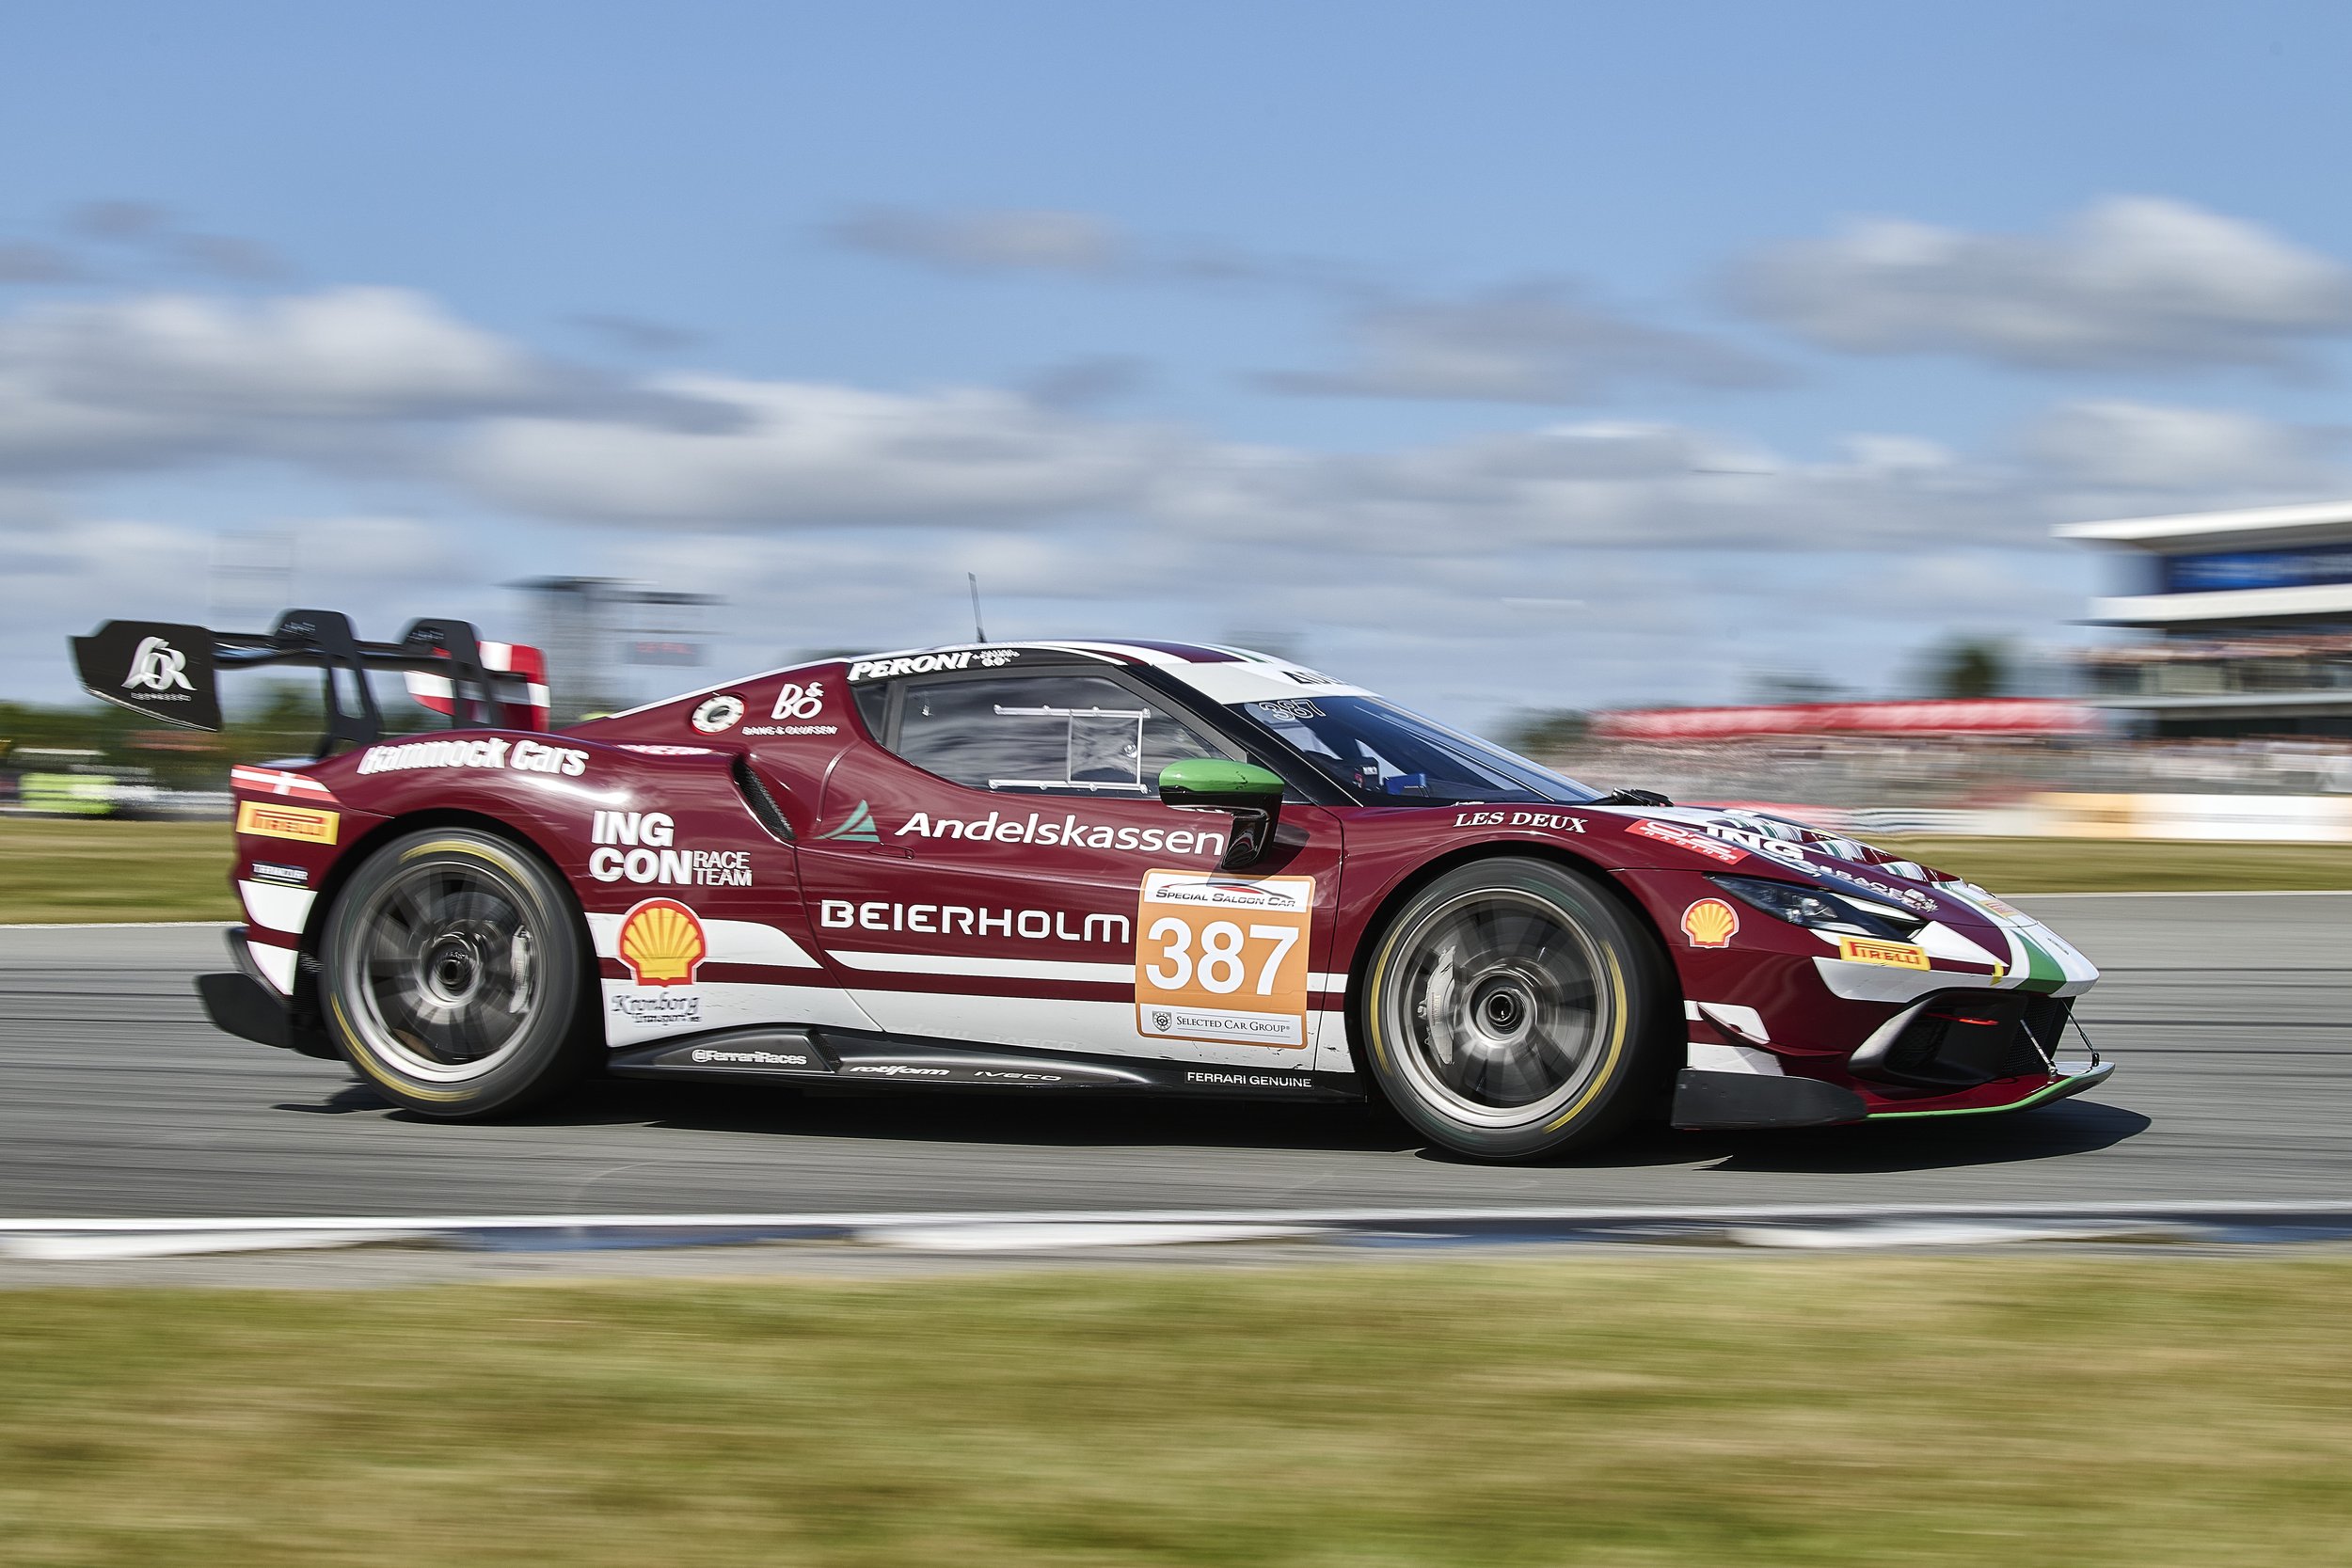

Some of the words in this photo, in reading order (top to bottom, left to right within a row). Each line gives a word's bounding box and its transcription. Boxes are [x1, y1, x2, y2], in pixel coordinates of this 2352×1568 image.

[847, 653, 973, 681] PERONI
[1259, 699, 1327, 721] 387
[741, 726, 776, 736] BANG
[775, 726, 786, 736] &
[785, 725, 838, 736] OLUFSEN
[509, 739, 590, 777] Cars
[591, 810, 675, 847] ING
[894, 811, 1224, 857] Andelskassen
[1453, 812, 1505, 829] LES
[1508, 813, 1589, 834] DEUX
[1706, 826, 1804, 861] ING
[589, 847, 693, 884] CON
[693, 850, 751, 869] RACE
[693, 867, 752, 886] TEAM
[1156, 888, 1209, 901] SPECIAL
[1212, 893, 1265, 906] SALOON
[1267, 896, 1295, 908] CAR
[820, 899, 1130, 943] BEIERHOLM
[1145, 916, 1299, 996] 387
[1849, 942, 1920, 965] PIRELLI
[1176, 1016, 1222, 1028] SELECTED
[1224, 1020, 1248, 1030] CAR
[691, 1049, 807, 1065] @FerrariRaces
[850, 1065, 950, 1076] rotiform
[974, 1070, 1062, 1082] IVECO
[1187, 1071, 1247, 1085] FERRARI
[1248, 1075, 1312, 1087] GENUINE
